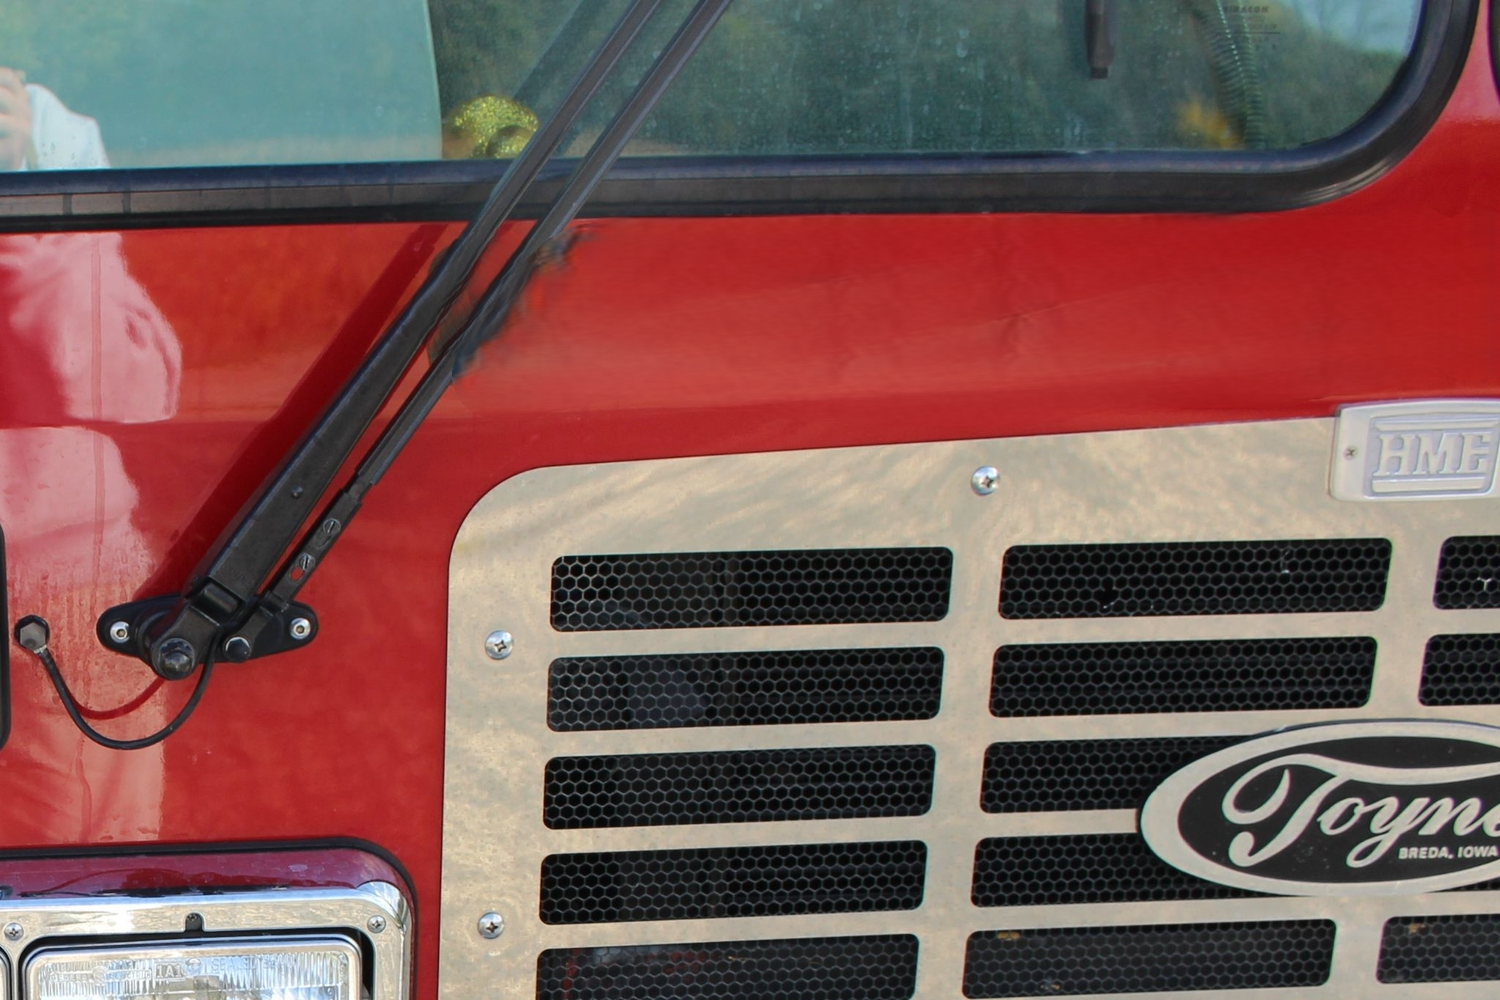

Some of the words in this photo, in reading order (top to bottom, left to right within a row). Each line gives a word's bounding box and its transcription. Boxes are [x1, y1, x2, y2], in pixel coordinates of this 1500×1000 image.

[1373, 431, 1492, 477] HME
[1398, 846, 1455, 859] BREDA,
[1457, 845, 1499, 858] IOWA
